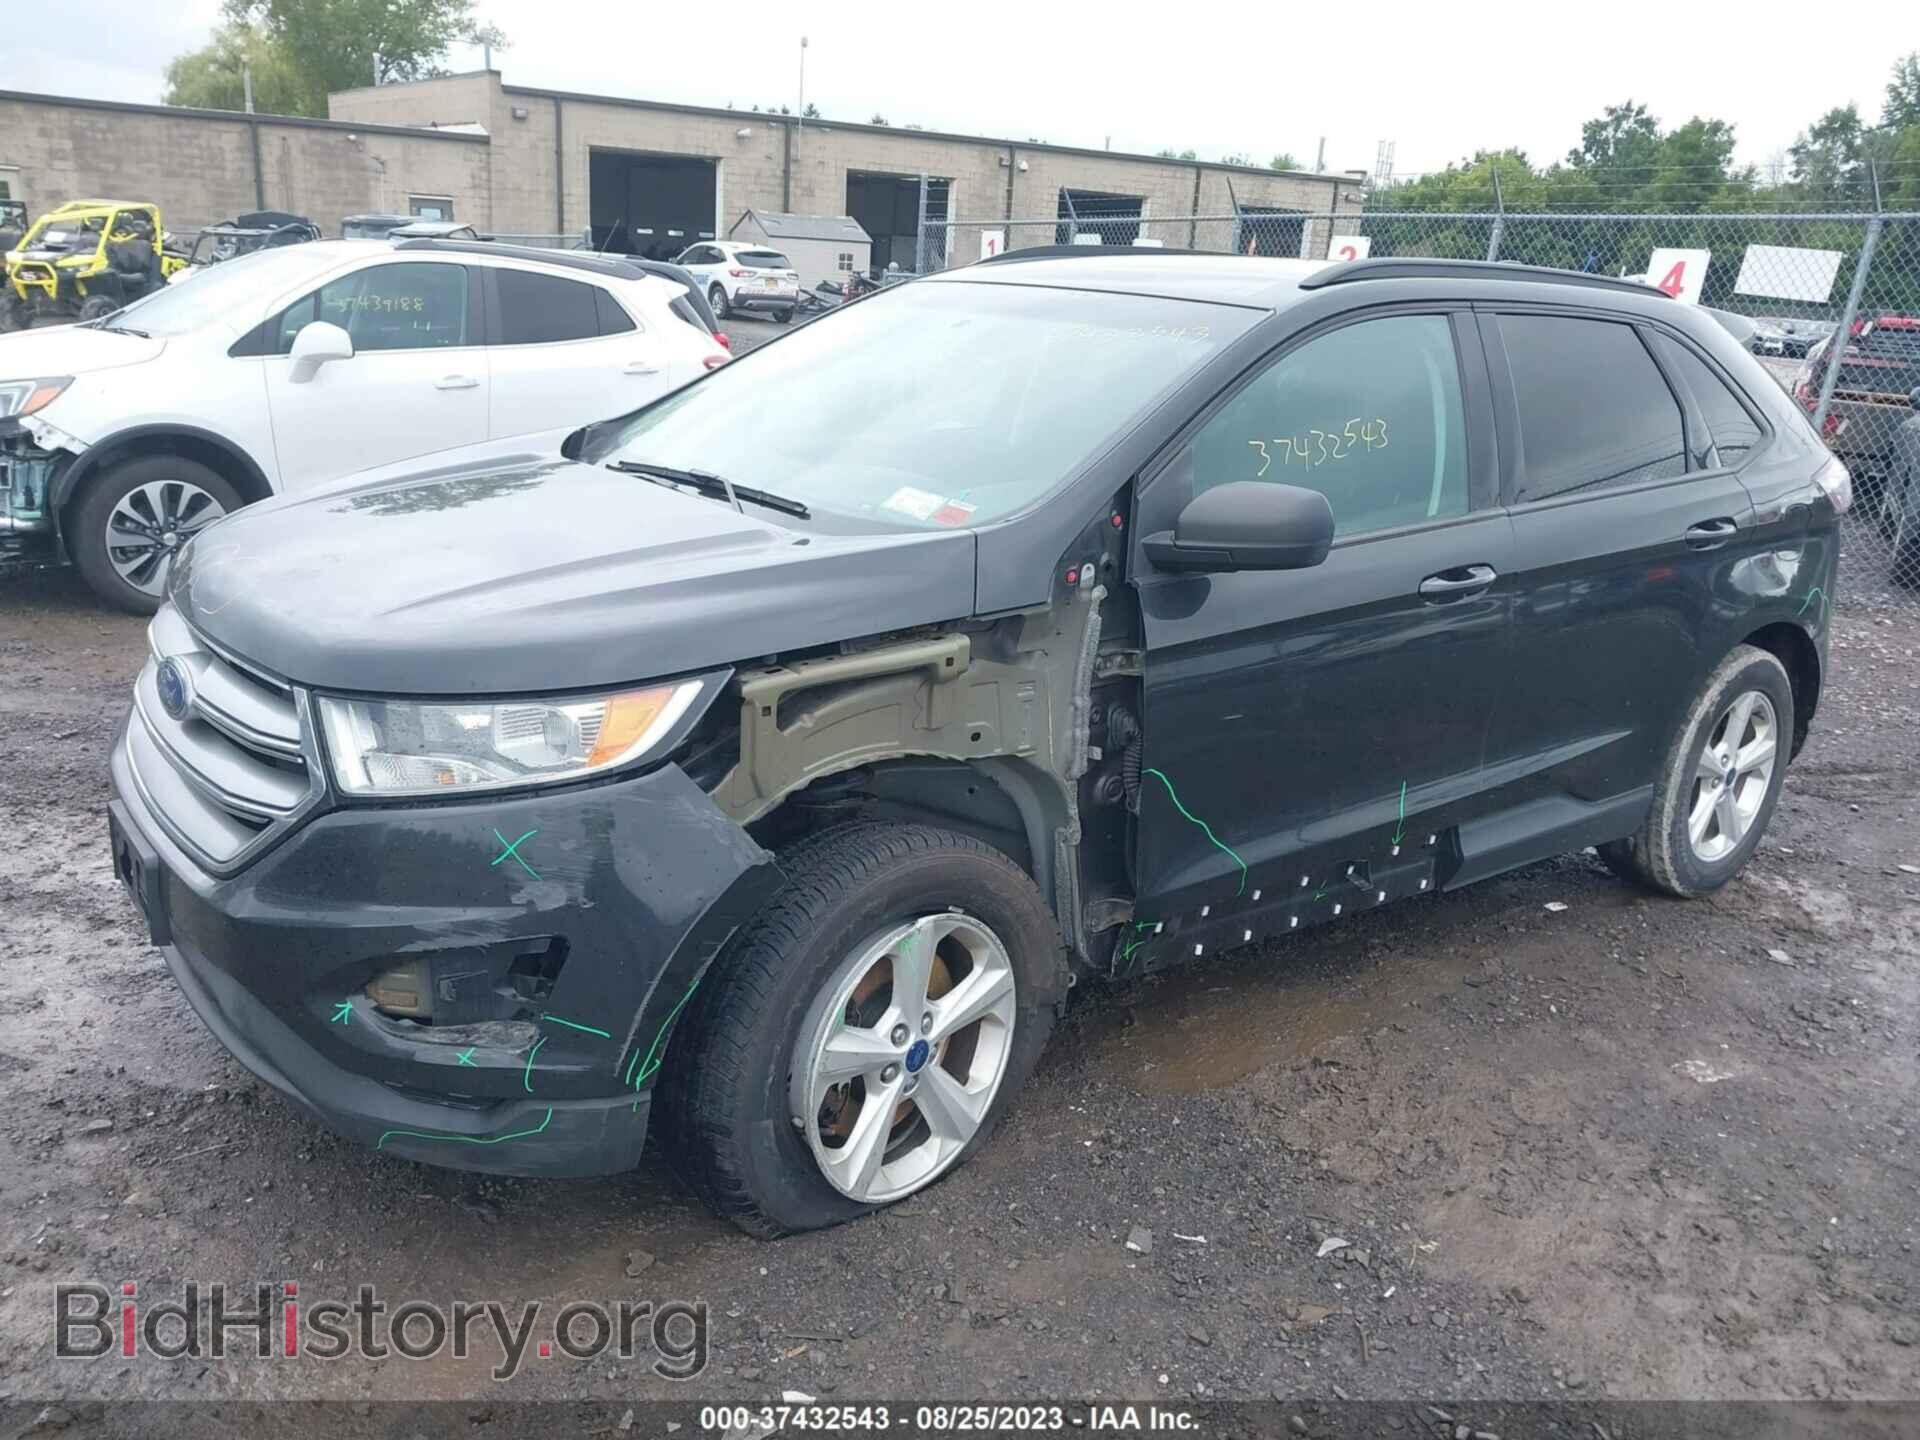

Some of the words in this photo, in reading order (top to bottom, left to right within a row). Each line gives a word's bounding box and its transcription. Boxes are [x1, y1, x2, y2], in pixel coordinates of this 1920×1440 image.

[986, 238, 996, 255] 1
[1658, 261, 1686, 298] 4
[1247, 417, 1389, 477] 37432543
